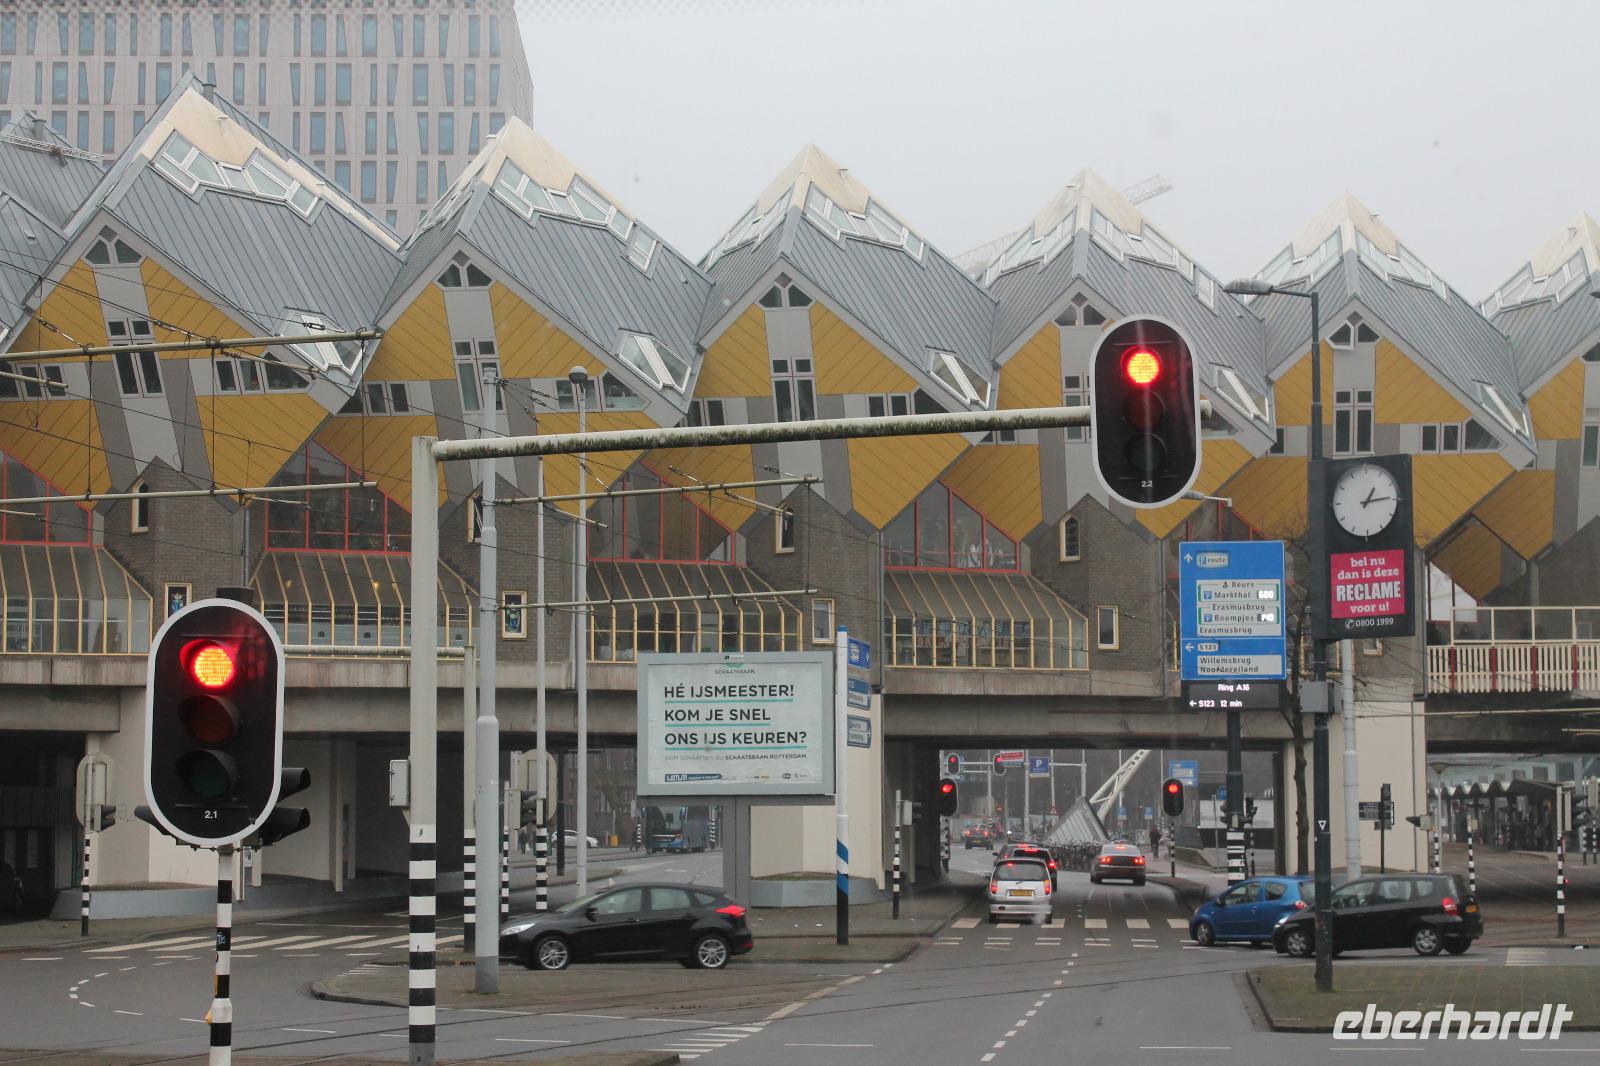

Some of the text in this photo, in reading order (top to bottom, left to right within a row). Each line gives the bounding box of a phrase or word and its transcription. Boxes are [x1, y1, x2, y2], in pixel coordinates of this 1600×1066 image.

[1141, 480, 1153, 488] 2.2
[1207, 556, 1226, 564] route
[1350, 557, 1386, 567] bel nu
[1338, 568, 1400, 580] dan is deze
[1214, 591, 1251, 599] Markthal
[1336, 581, 1401, 601] RECLAME
[1212, 604, 1265, 612] Erasmusbrug
[1350, 602, 1389, 613] voor u!
[1214, 614, 1253, 623] Boompjes
[1356, 618, 1394, 627] 0800 1999
[1200, 627, 1252, 635] Erasmusbrug
[1200, 657, 1251, 665] Willemsbrug
[664, 683, 794, 698] HÉ IJSMEESTER!
[1218, 684, 1234, 692] Ring
[1198, 700, 1243, 708] S123 12 min
[664, 708, 771, 722] KOM JE SNEL
[664, 731, 807, 745] ONS IJS KEUREN?
[204, 810, 218, 819] 2.1
